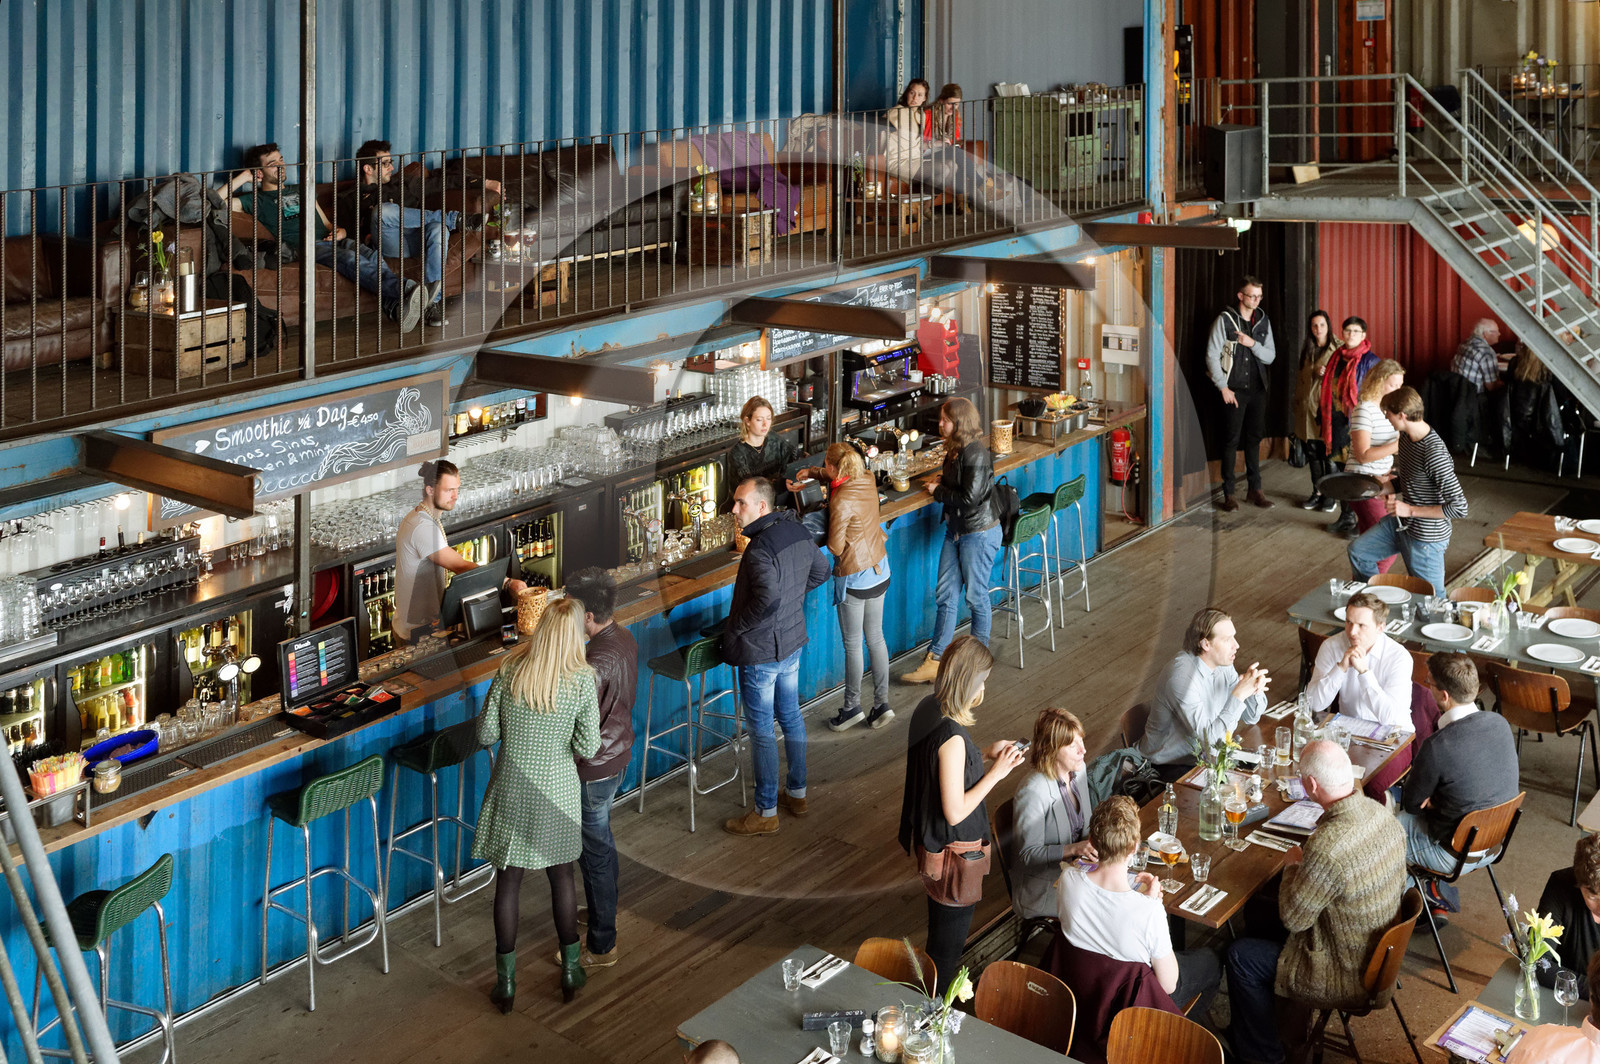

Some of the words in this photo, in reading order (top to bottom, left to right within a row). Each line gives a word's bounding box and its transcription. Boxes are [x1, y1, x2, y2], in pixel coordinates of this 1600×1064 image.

[215, 417, 293, 451] Smoothie
[316, 406, 348, 432] Dag
[287, 452, 299, 466] &
